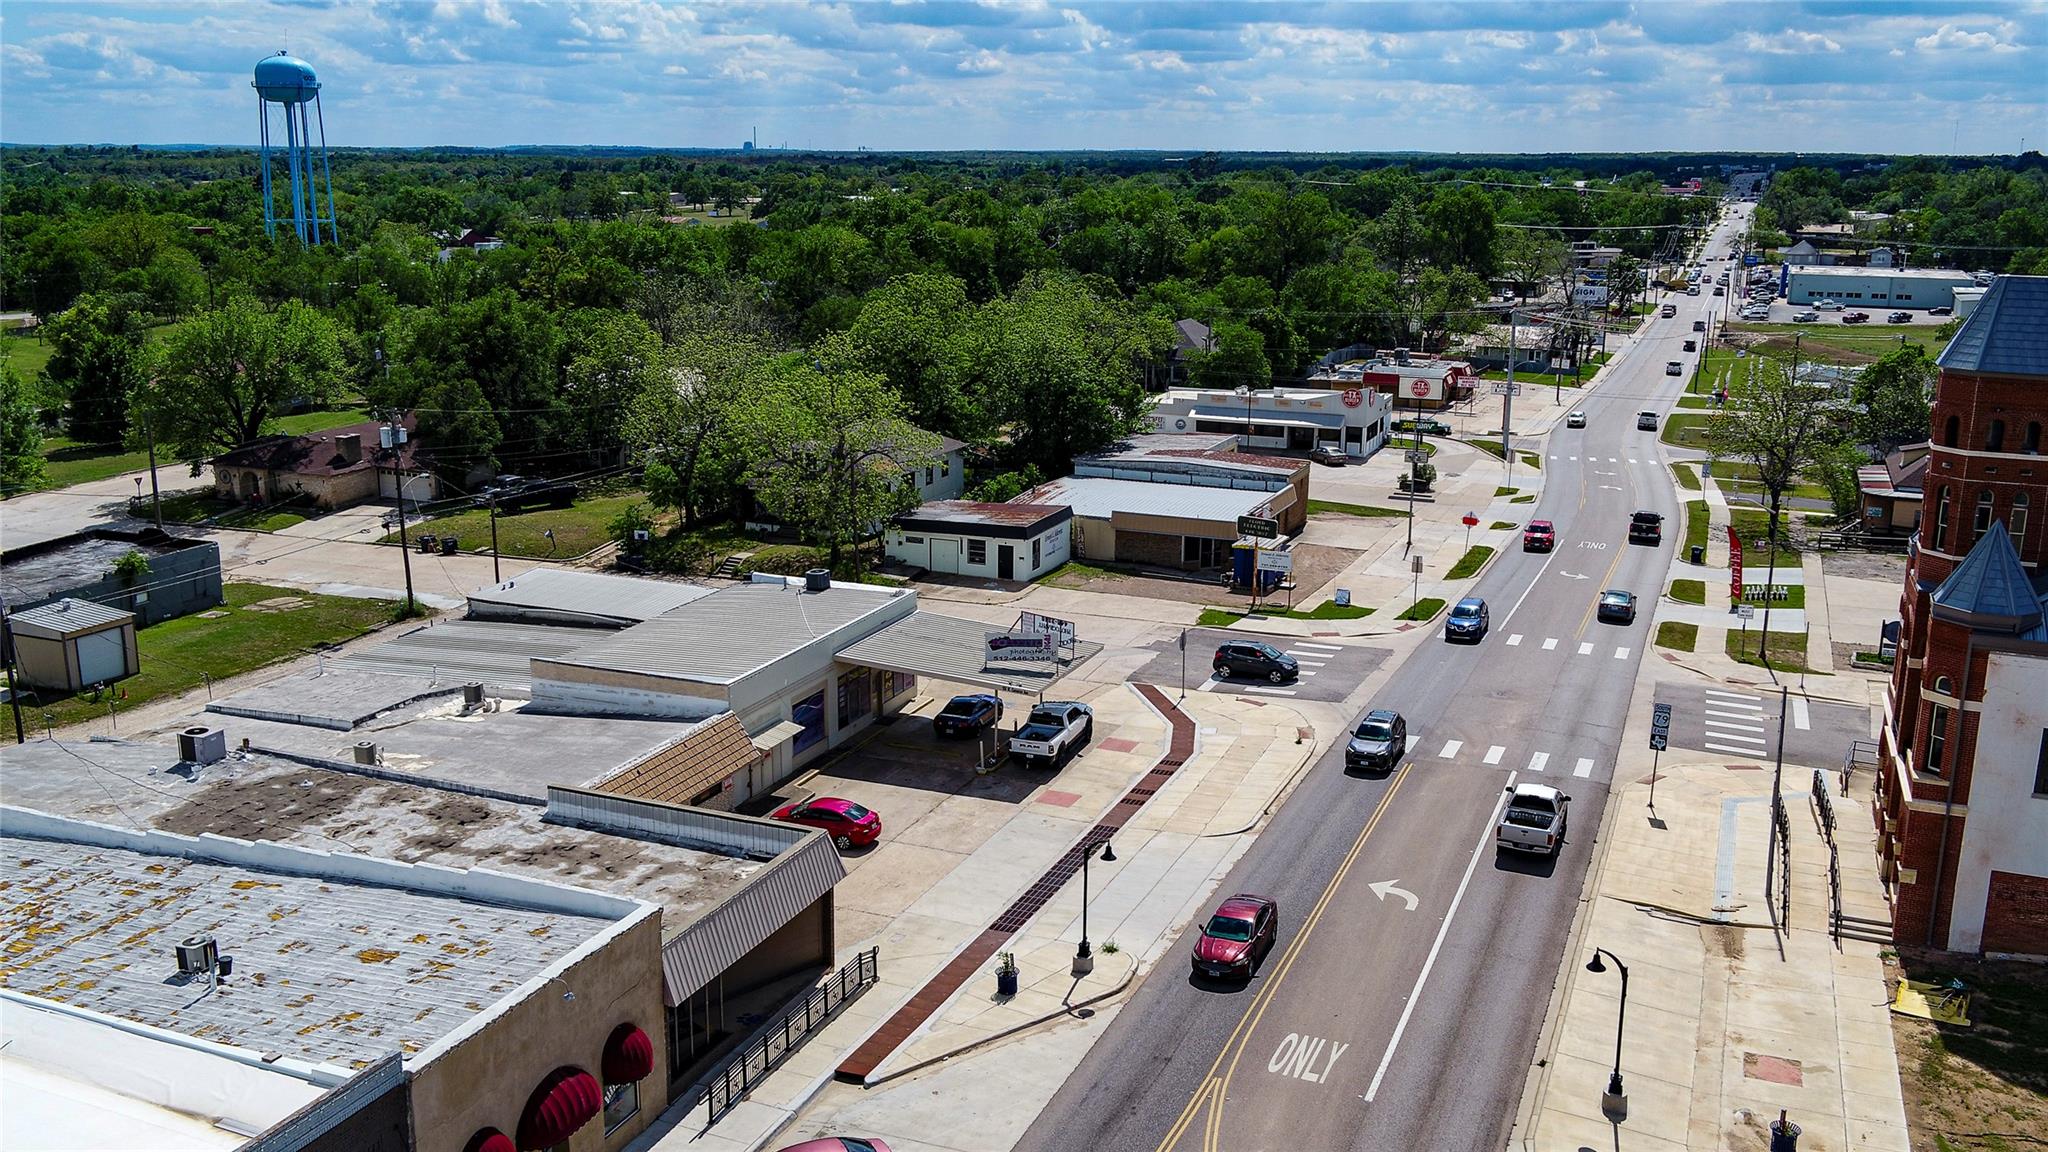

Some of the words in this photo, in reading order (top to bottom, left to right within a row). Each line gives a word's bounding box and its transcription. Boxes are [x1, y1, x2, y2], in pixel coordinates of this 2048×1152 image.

[1578, 541, 1607, 550] ONLY
[1730, 546, 1741, 595] COFFEE
[1655, 714, 1669, 724] 79
[1268, 1032, 1350, 1084] ONLY
